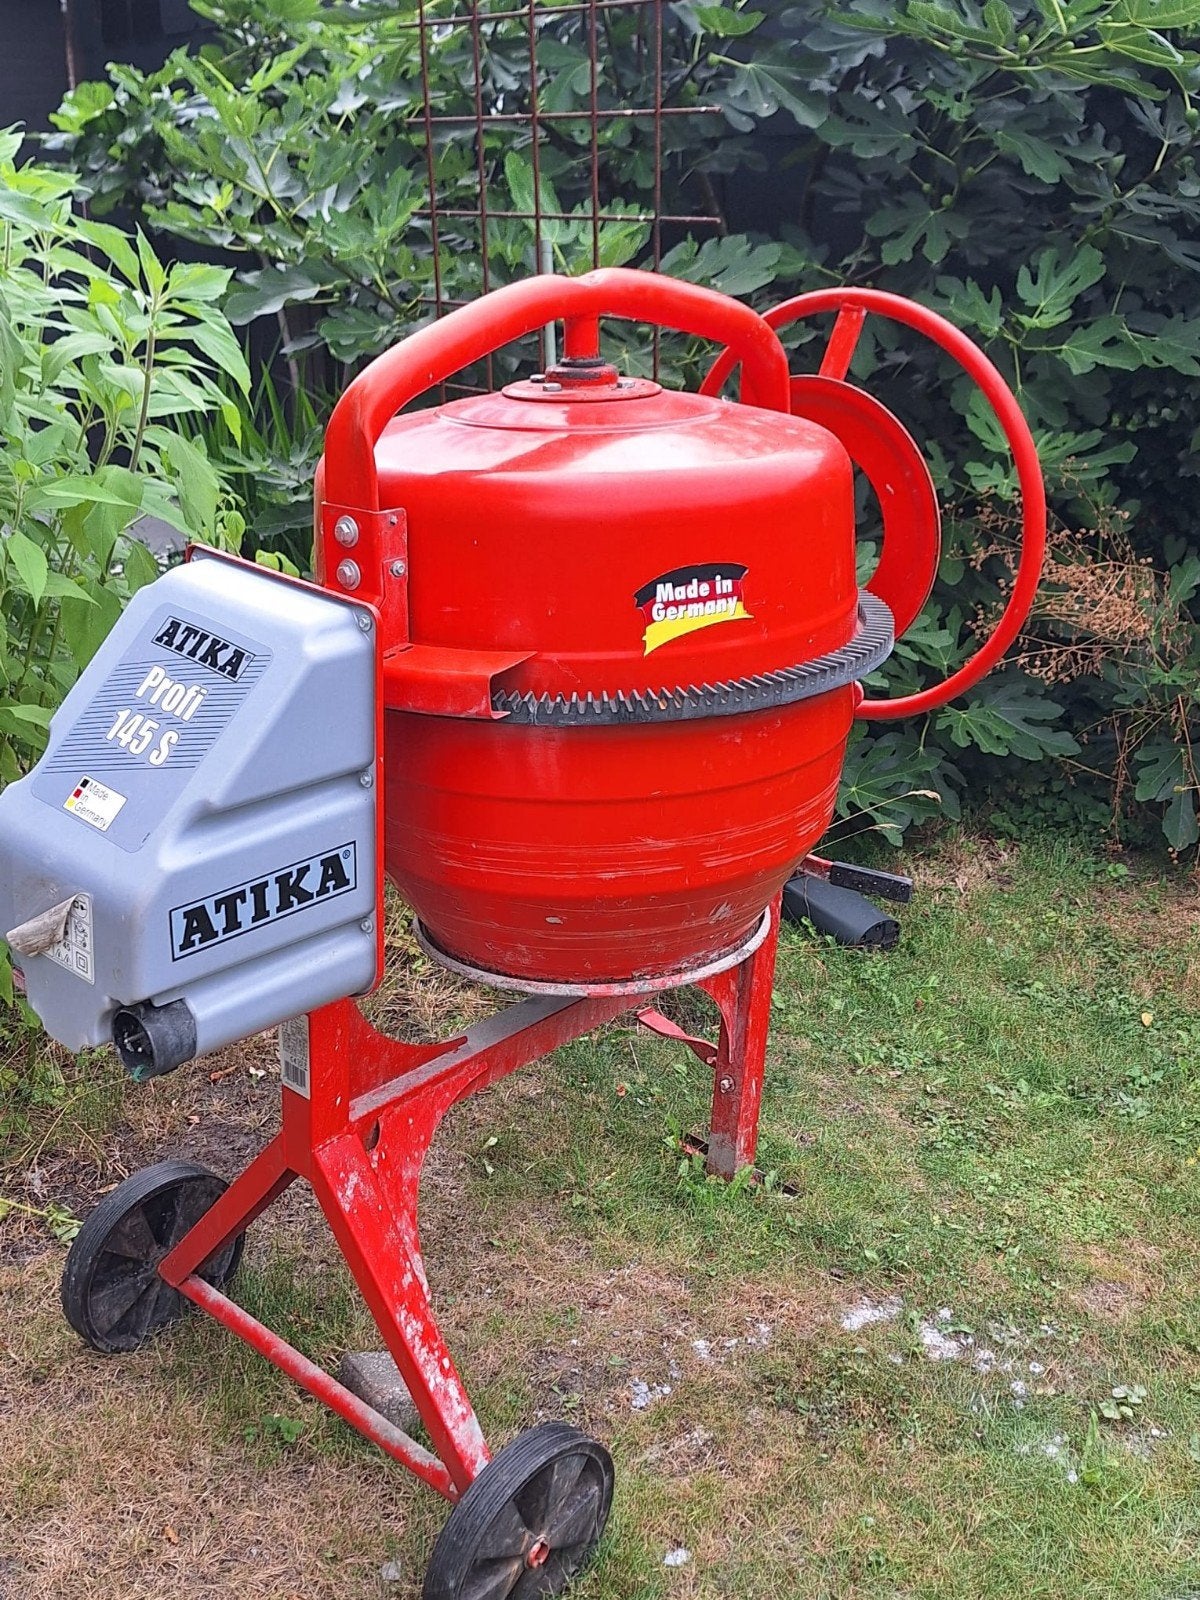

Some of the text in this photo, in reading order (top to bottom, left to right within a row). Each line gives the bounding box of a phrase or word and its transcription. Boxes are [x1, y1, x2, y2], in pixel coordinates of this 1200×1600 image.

[655, 574, 733, 603] Made in
[651, 595, 738, 622] Germany
[154, 619, 246, 679] ATIKA
[134, 664, 209, 722] Profi
[105, 708, 180, 766] 145 S
[80, 793, 89, 803] in
[86, 781, 109, 801] Made
[74, 801, 110, 829] Germany
[178, 852, 351, 953] ATIKA
